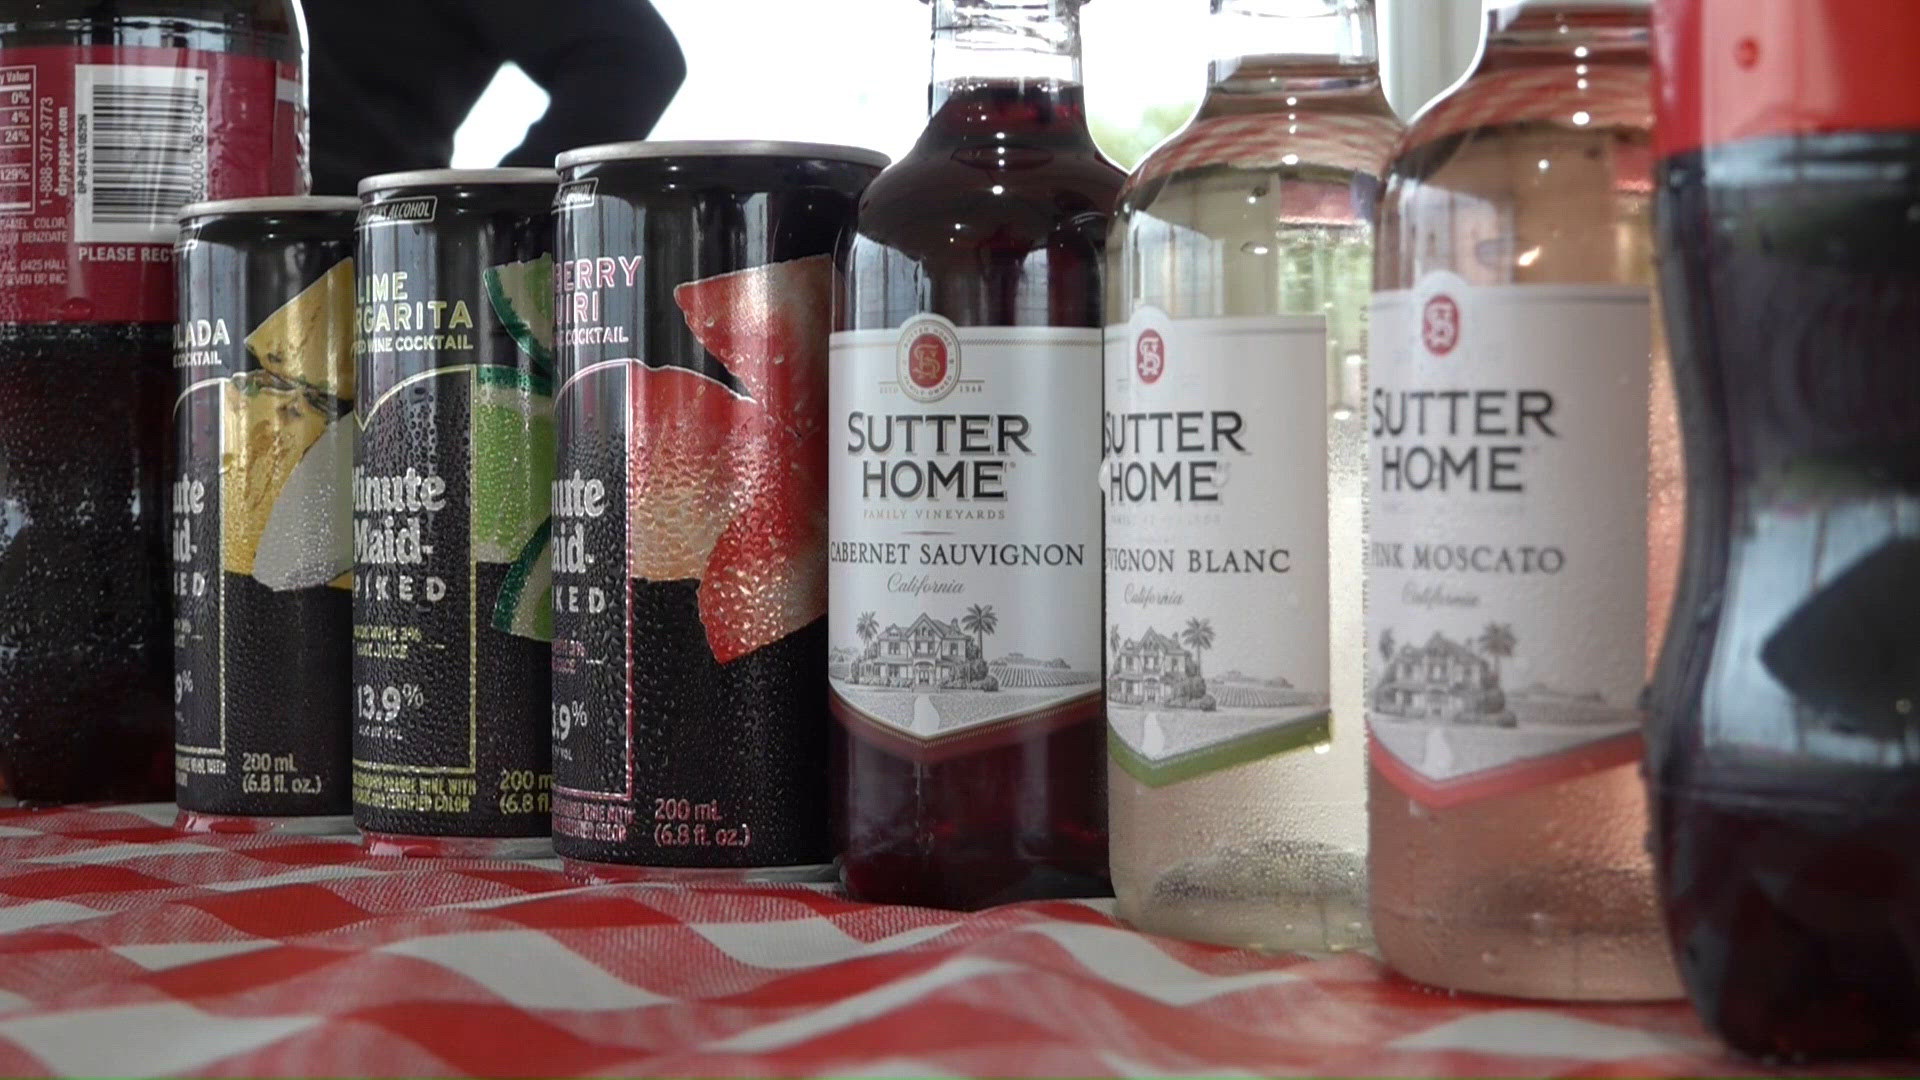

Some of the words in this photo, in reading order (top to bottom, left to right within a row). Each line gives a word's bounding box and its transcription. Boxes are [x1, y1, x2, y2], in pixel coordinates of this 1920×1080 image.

[7, 71, 30, 82] Value
[11, 92, 30, 105] 0%
[11, 111, 30, 123] 4%
[5, 130, 30, 143] 24%
[40, 97, 54, 206] 1-888-377-3773
[55, 106, 70, 197] drpepper.com
[387, 201, 431, 222] ALCOHOL
[22, 231, 67, 243] BENZOATE
[20, 259, 43, 271] 6425
[44, 259, 67, 271] HALL
[78, 246, 136, 262] PLEASE
[357, 271, 409, 303] LIME
[367, 337, 393, 353] WINE
[395, 334, 473, 352] COCKTAIL
[565, 326, 629, 345] COCKTAIL
[178, 350, 222, 368] COCKTAIL
[1373, 388, 1557, 437] SUTTER
[847, 411, 1034, 455] SUTTER
[1105, 410, 1248, 454] SUTTER
[1382, 445, 1522, 492] HOME
[1110, 460, 1220, 503] HOME
[863, 509, 907, 520] FAMILY
[915, 509, 1007, 520] VINEYARDS
[830, 541, 911, 566] CABERNET
[919, 543, 1085, 566] SAUVIGNON
[1187, 549, 1292, 573] BLANC
[1411, 543, 1566, 574] MOSCATO
[886, 570, 966, 598] California
[1124, 582, 1186, 609] California
[357, 683, 424, 722] 13.9%
[242, 752, 272, 772] 200
[274, 752, 299, 773] mL
[242, 773, 271, 794] (6.8
[274, 774, 288, 793] fl.
[291, 774, 323, 795] oz.)
[448, 779, 477, 797] WITH
[500, 770, 535, 791] 200
[434, 795, 471, 814] COLOR
[500, 791, 535, 814] (6.8
[654, 798, 691, 821] 200
[693, 798, 723, 822] mL
[654, 823, 691, 847] (6.8
[693, 823, 712, 847] fl.
[715, 823, 750, 848] oz.)
